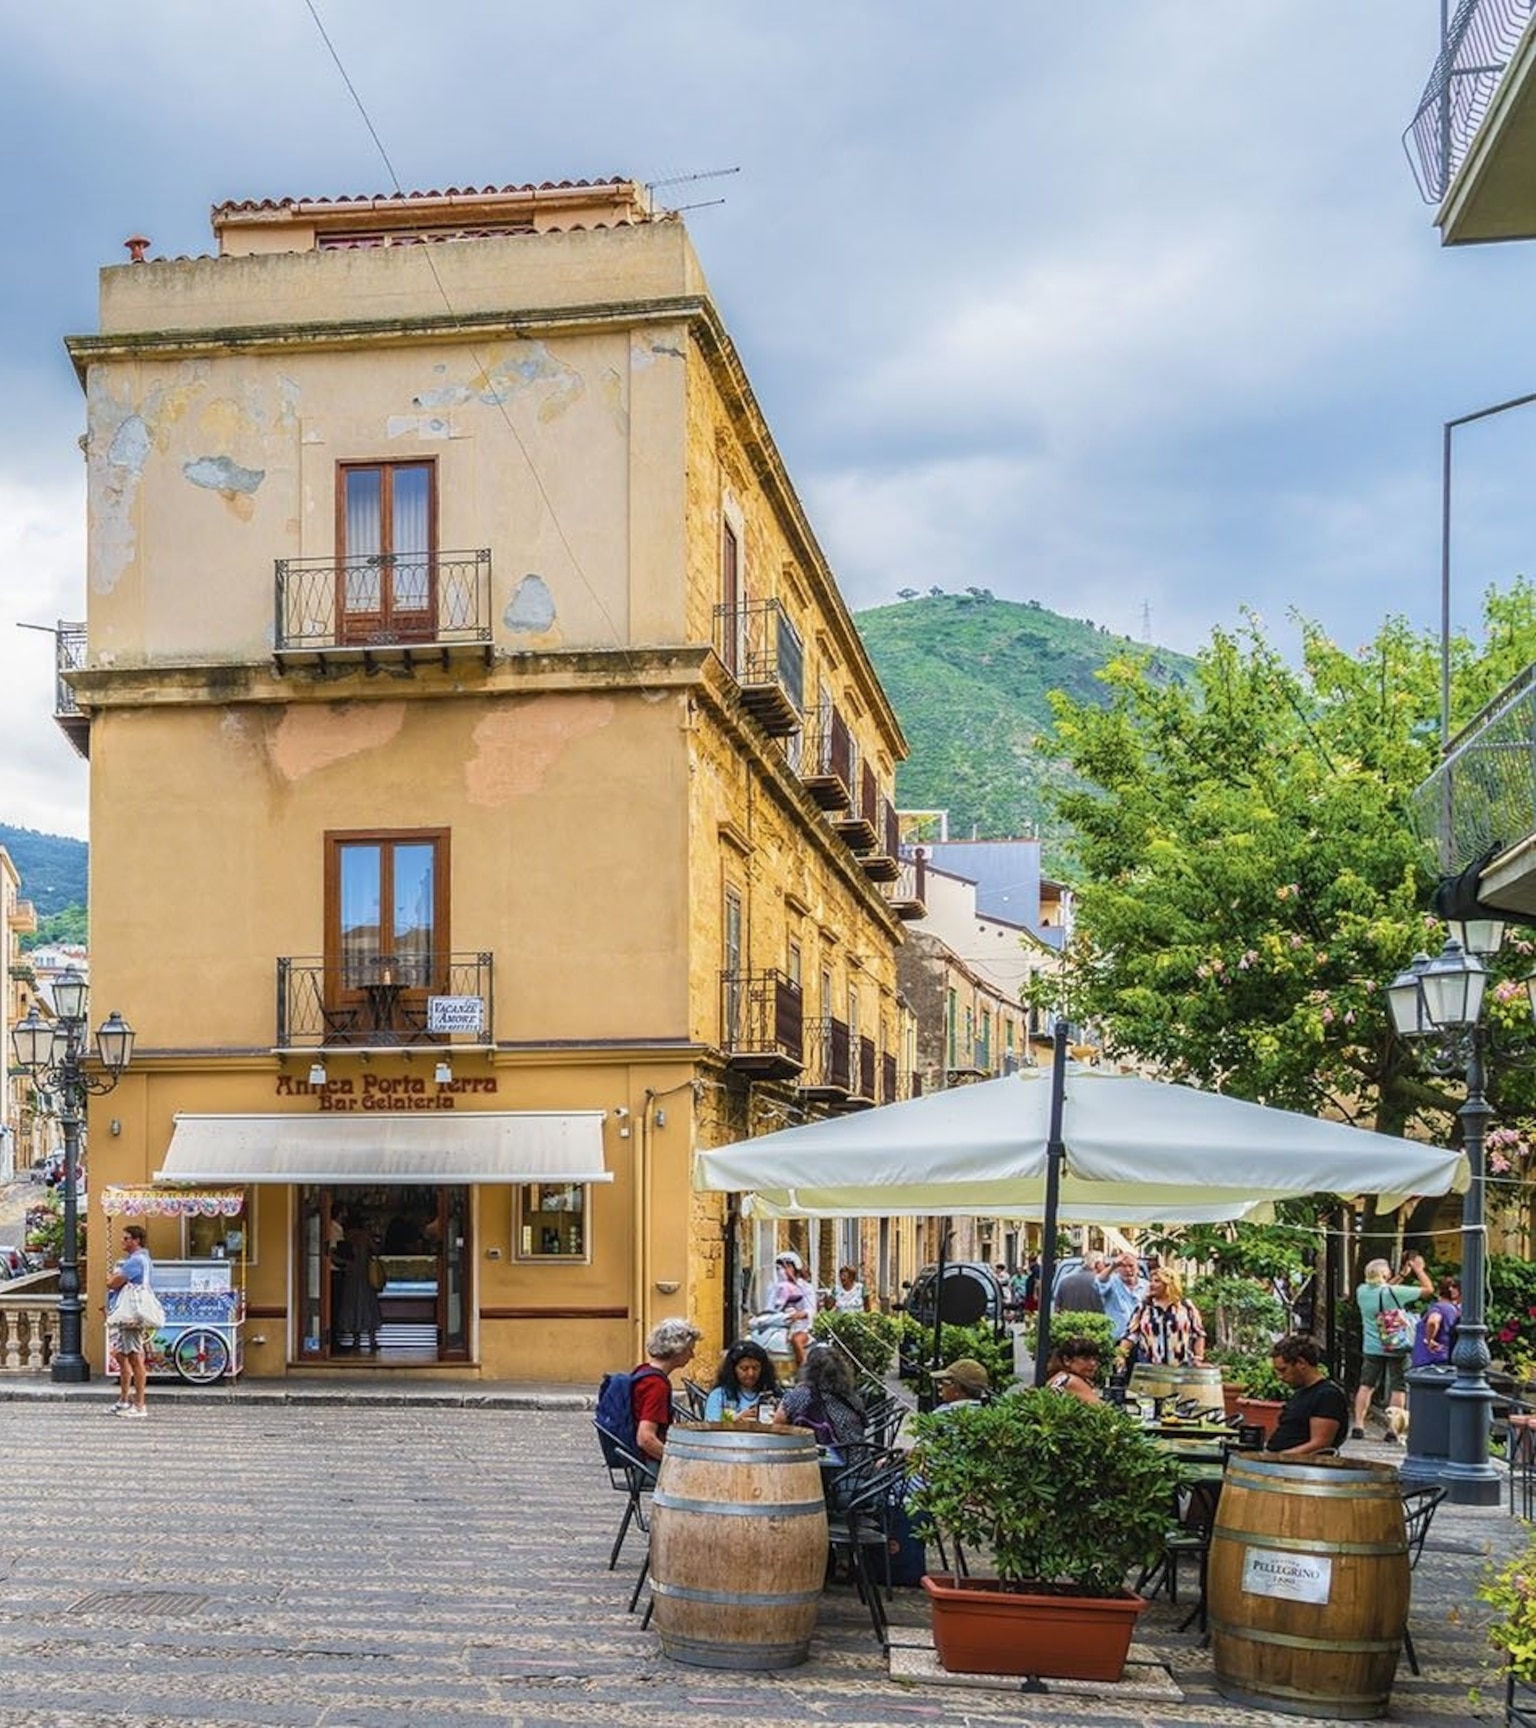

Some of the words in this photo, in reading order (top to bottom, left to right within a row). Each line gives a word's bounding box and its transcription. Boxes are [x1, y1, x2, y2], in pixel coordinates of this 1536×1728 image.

[362, 1074, 426, 1094] Porta
[319, 1095, 358, 1110] Bar
[362, 1095, 455, 1110] Gelateria
[1253, 1560, 1320, 1580] PELLEGRINO
